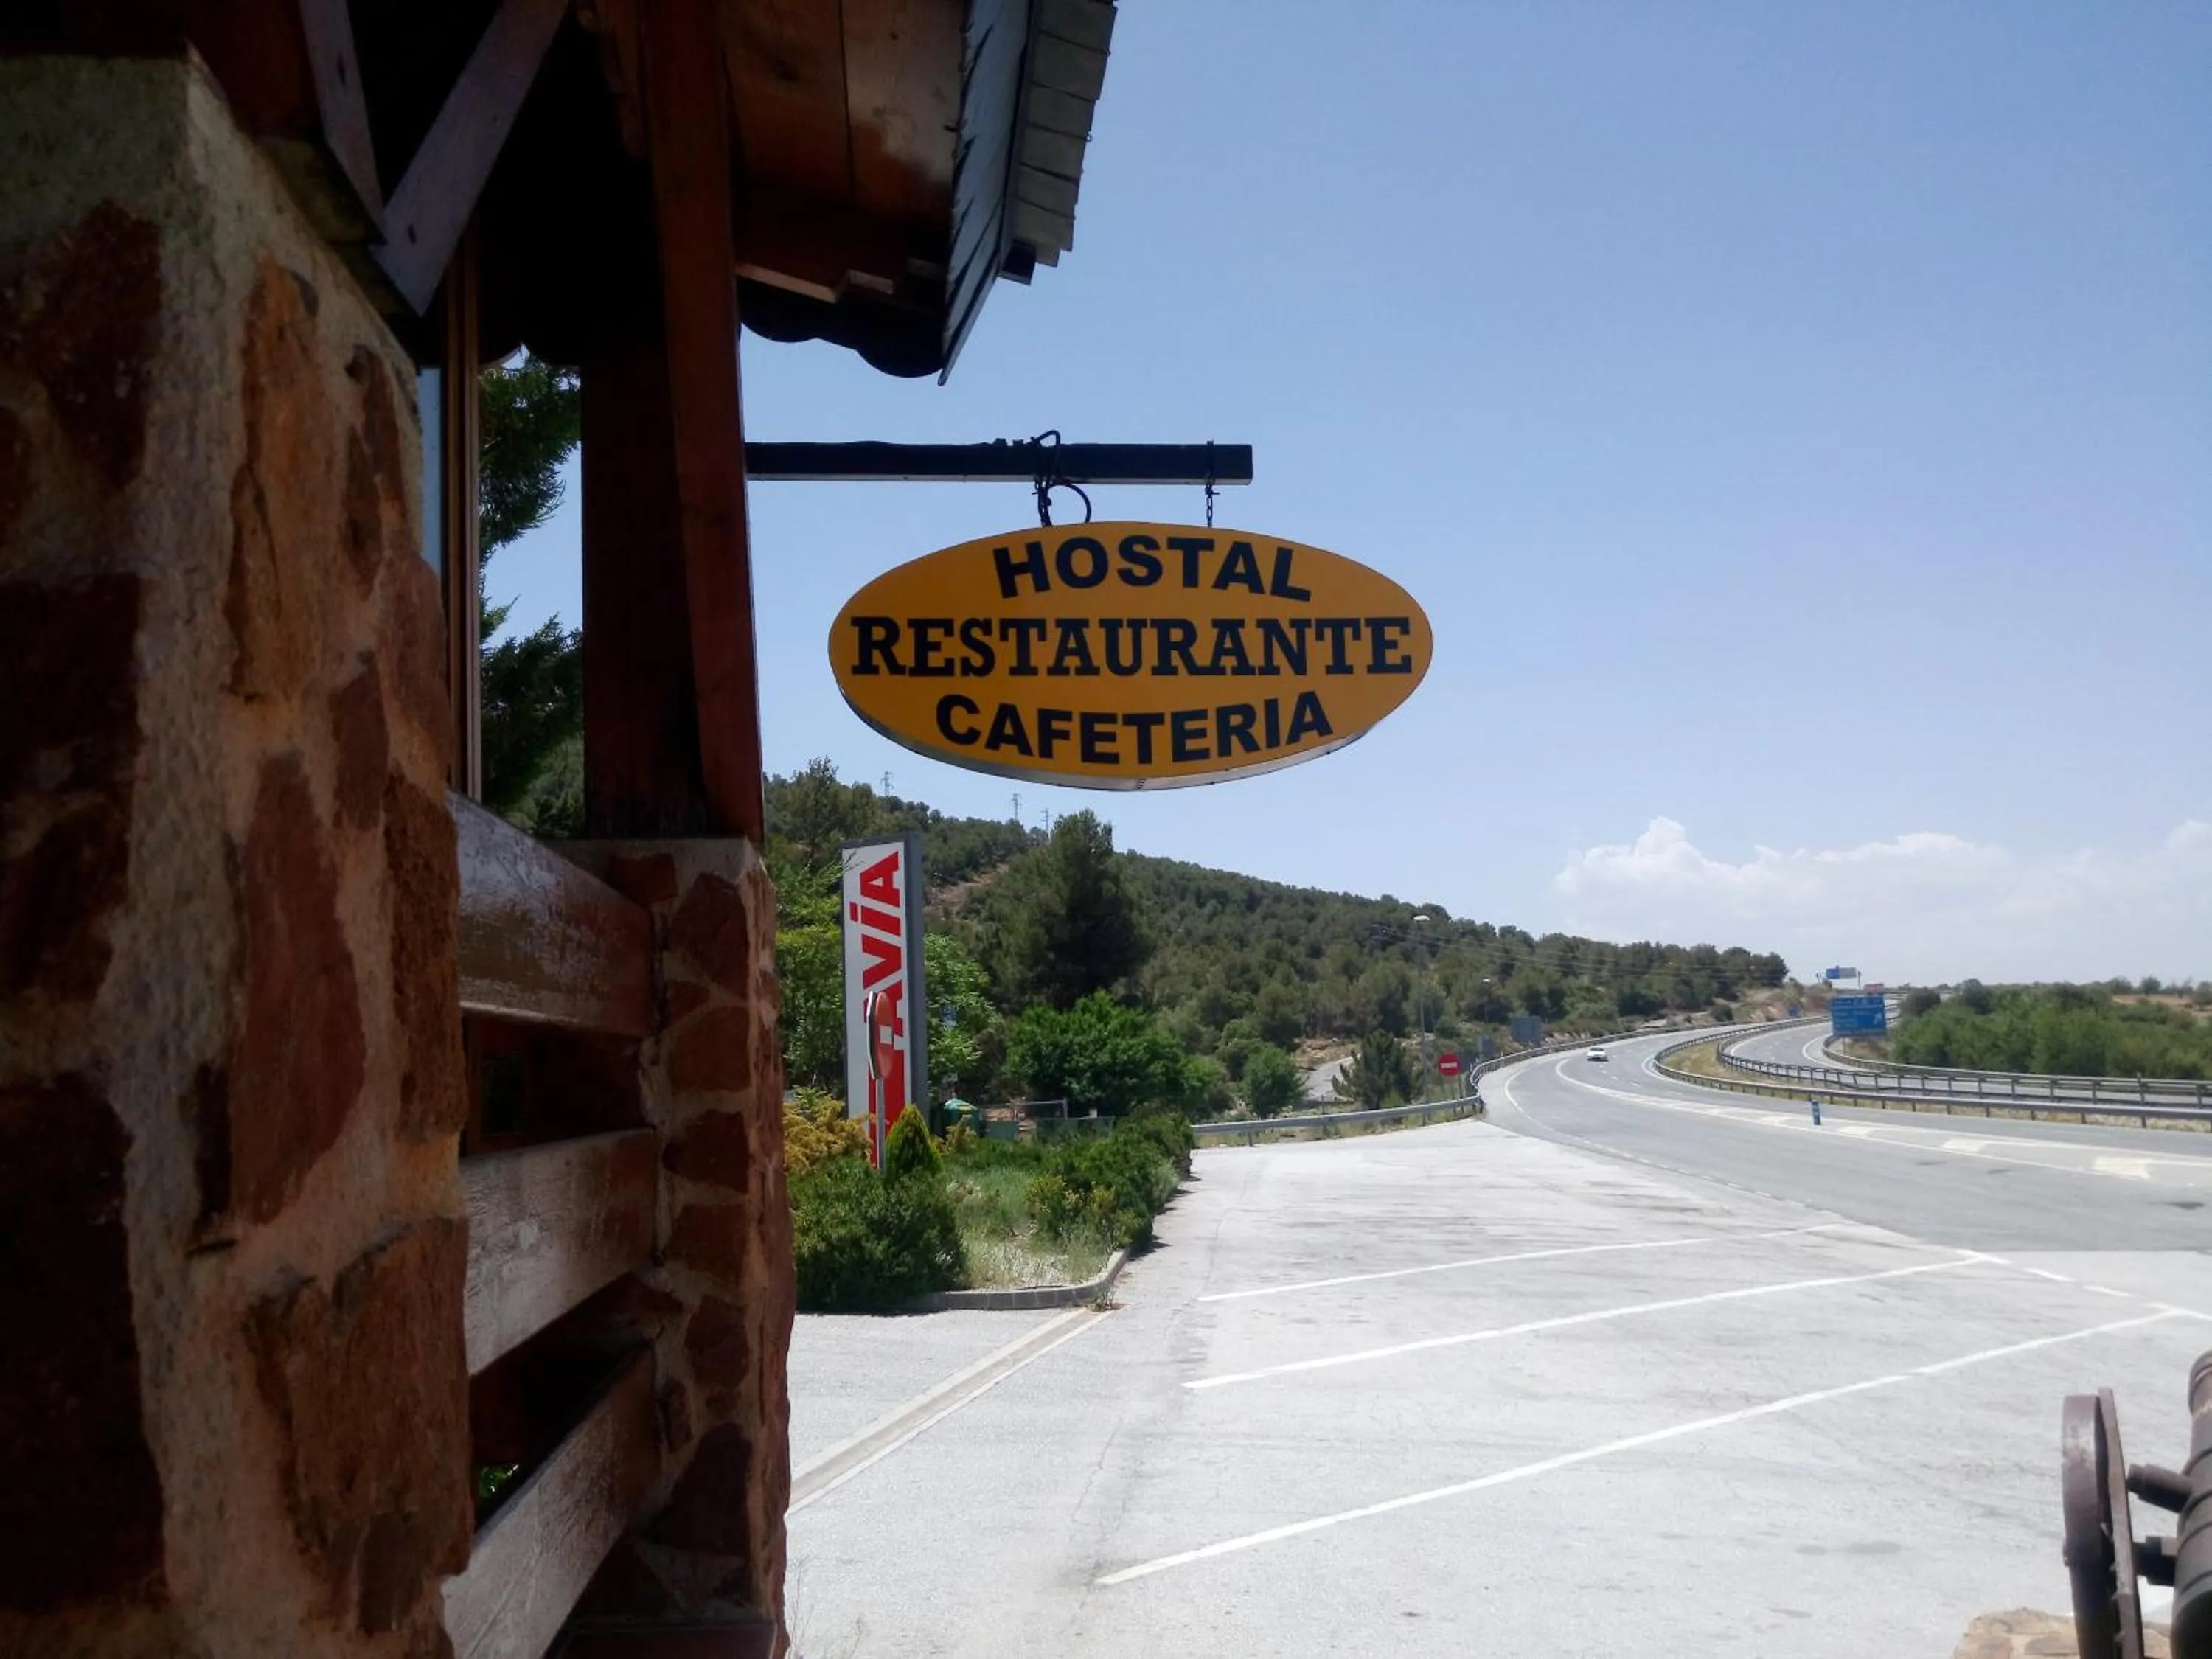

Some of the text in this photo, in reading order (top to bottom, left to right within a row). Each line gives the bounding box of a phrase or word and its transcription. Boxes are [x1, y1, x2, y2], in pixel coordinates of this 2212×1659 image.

[992, 535, 1311, 602] HOSTAL
[850, 616, 1412, 678] RESTAURANTE
[936, 691, 1333, 765] CAFETERIA
